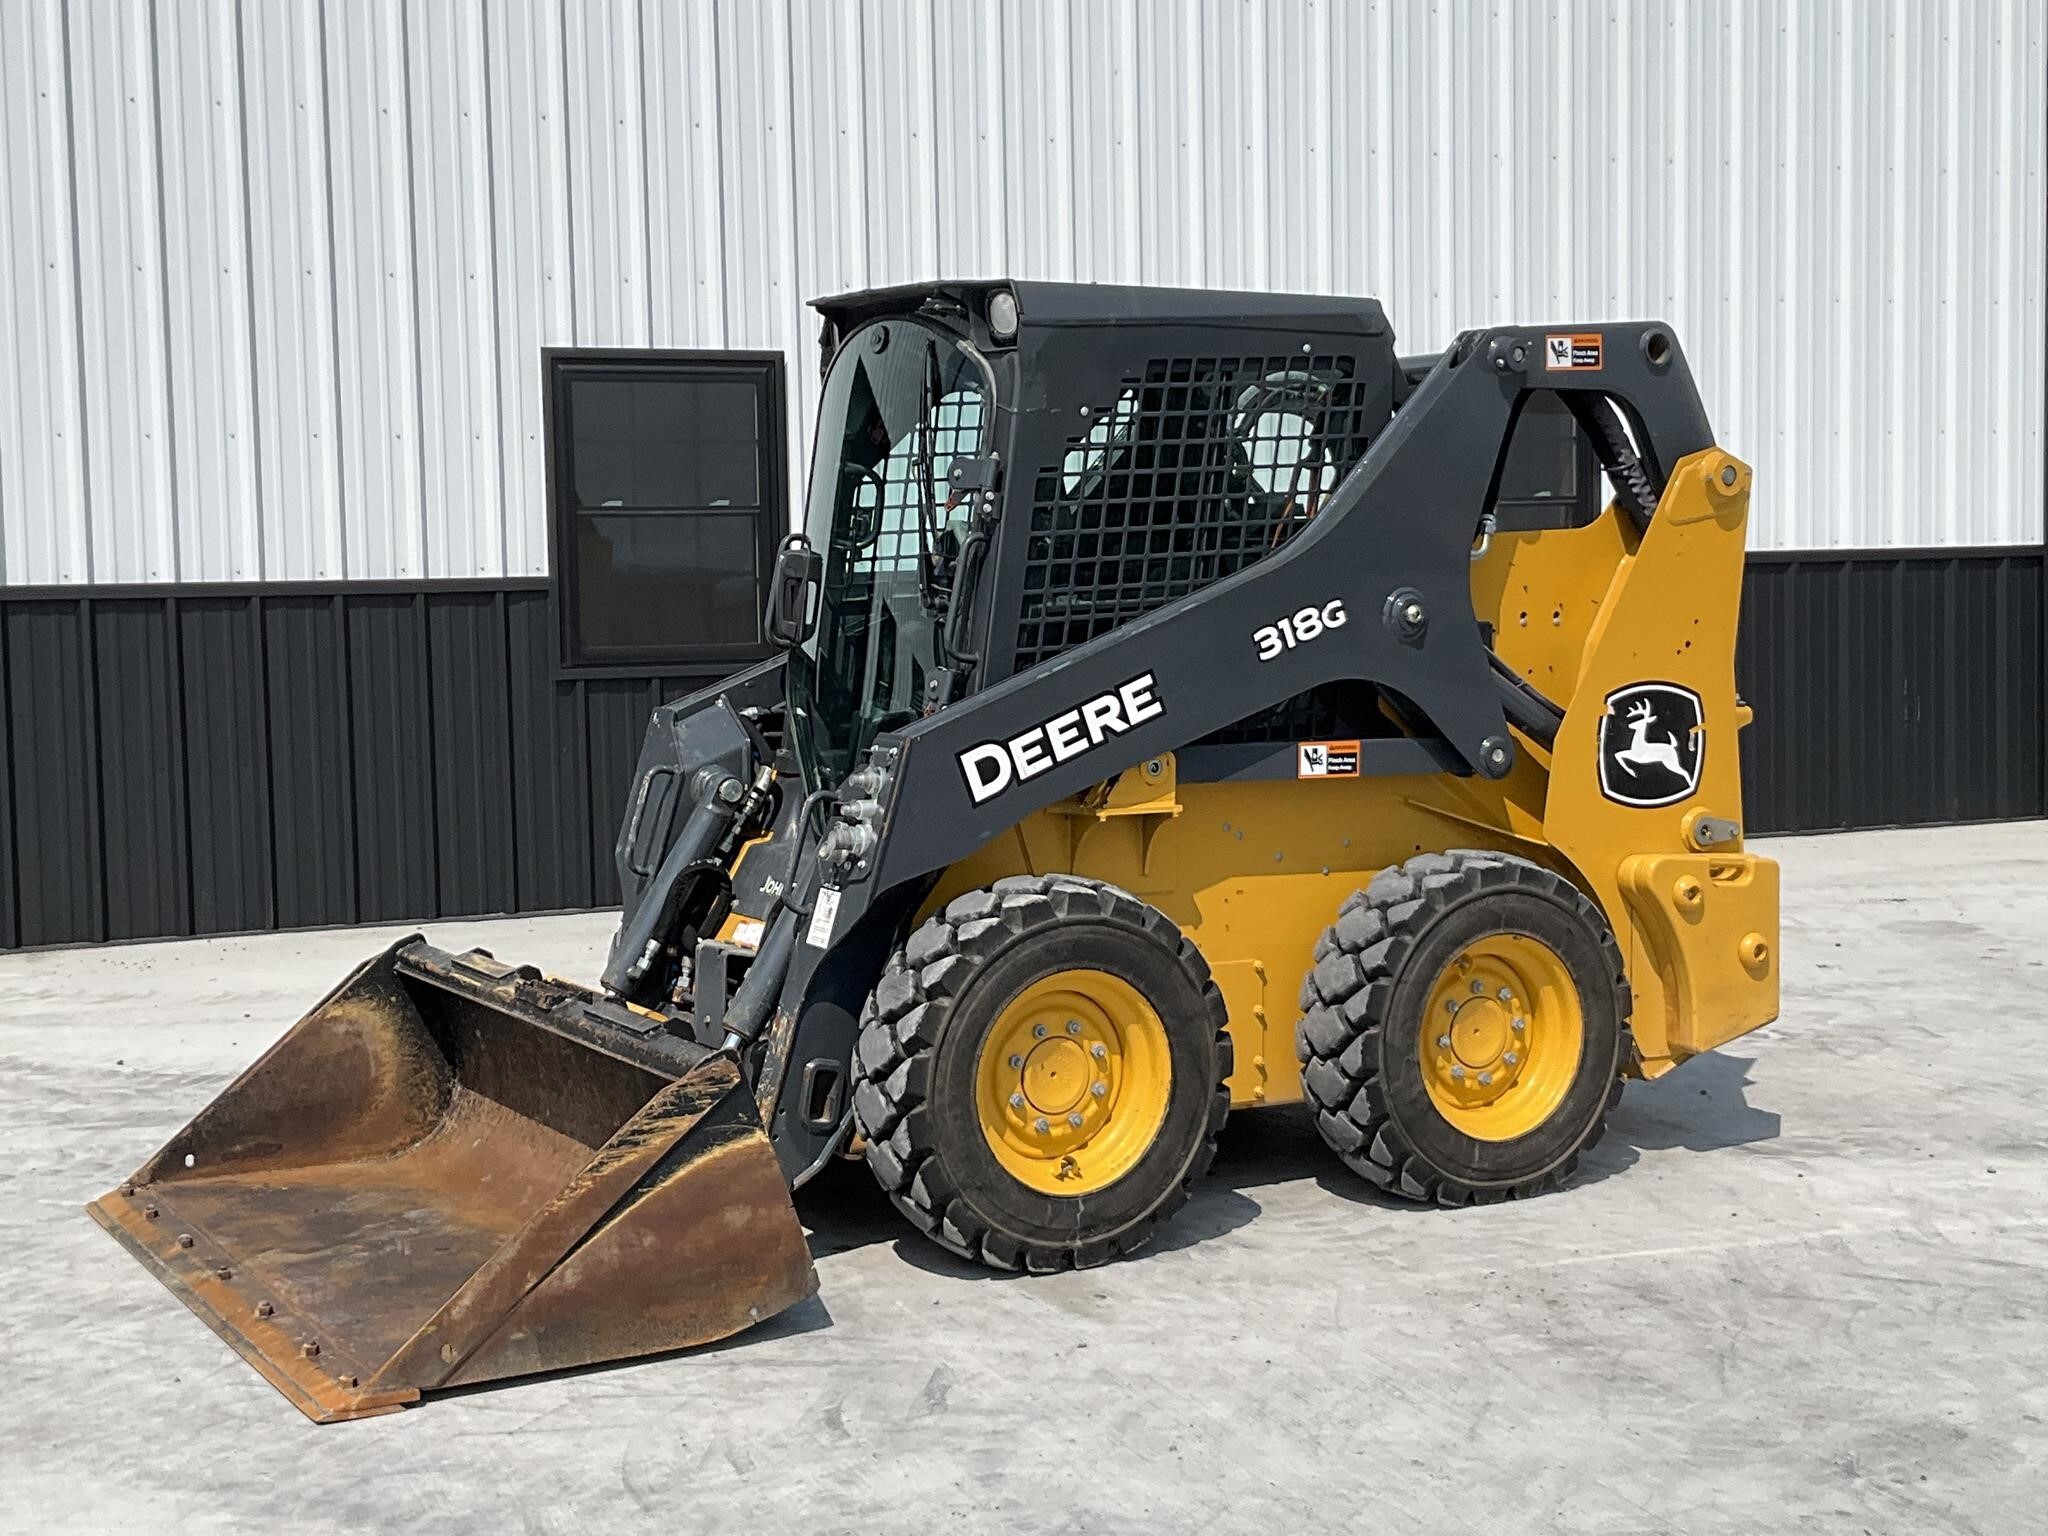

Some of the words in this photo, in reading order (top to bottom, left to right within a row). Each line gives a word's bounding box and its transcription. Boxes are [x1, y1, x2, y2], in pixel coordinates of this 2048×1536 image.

[1253, 599, 1347, 661] 318G
[959, 673, 1164, 804] DEERE
[759, 875, 785, 896] JOH
